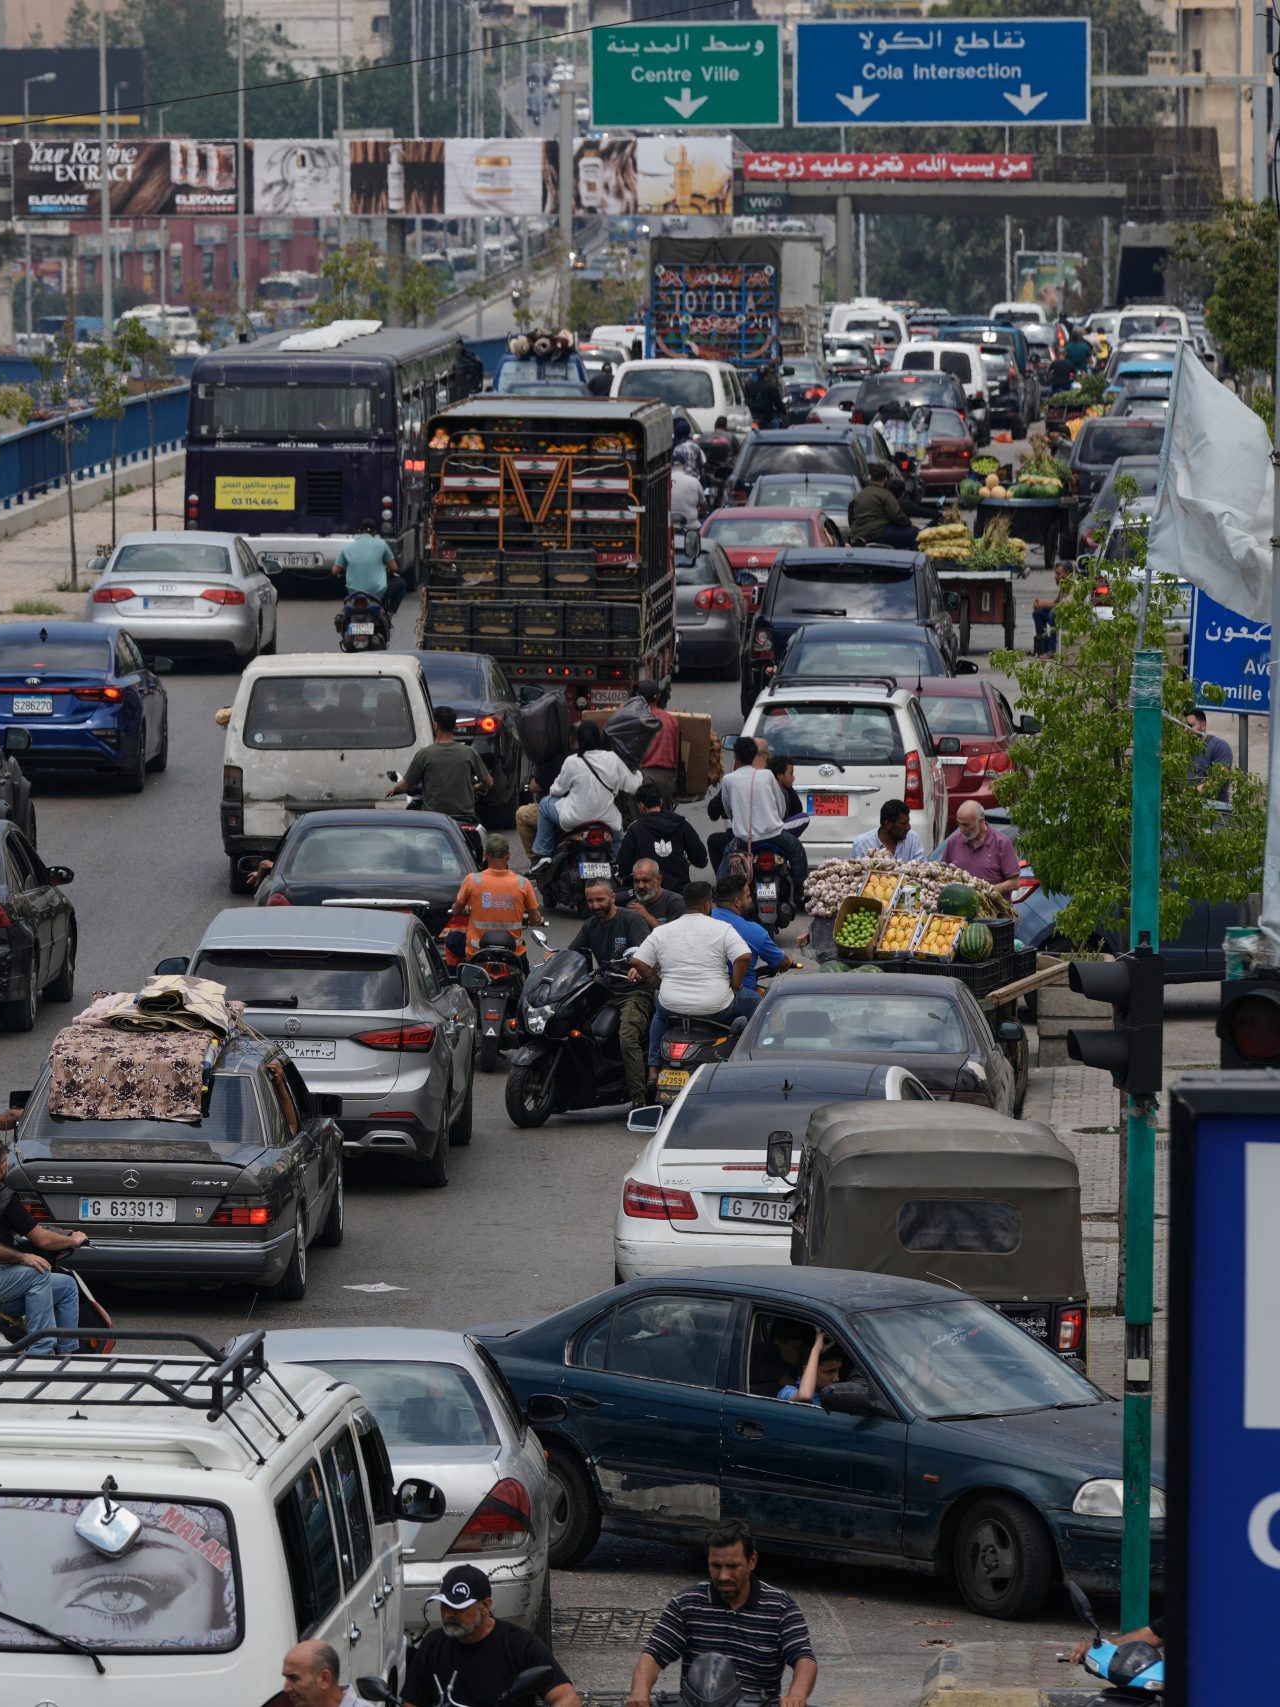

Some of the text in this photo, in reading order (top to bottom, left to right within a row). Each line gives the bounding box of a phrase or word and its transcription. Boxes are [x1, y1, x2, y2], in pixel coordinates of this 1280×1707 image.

[607, 33, 765, 57] وسط المدينة
[859, 29, 1026, 56] تقاطع الكولا
[631, 66, 739, 82] Centre Ville
[862, 63, 1022, 81] Cola Intersection
[28, 142, 67, 164] Your
[748, 156, 805, 177] زوجته
[809, 158, 854, 177] عليه
[950, 160, 995, 177] يسب
[998, 157, 1028, 177] من
[28, 195, 88, 205] ELEGANCE
[175, 195, 235, 205] ELEGANCE
[672, 290, 755, 312] TOYOTA
[1201, 681, 1262, 701] Cmille
[14, 699, 52, 711] S286270
[92, 1201, 164, 1217] G 633913
[732, 1200, 742, 1216] G
[160, 1504, 231, 1572] MALAK
